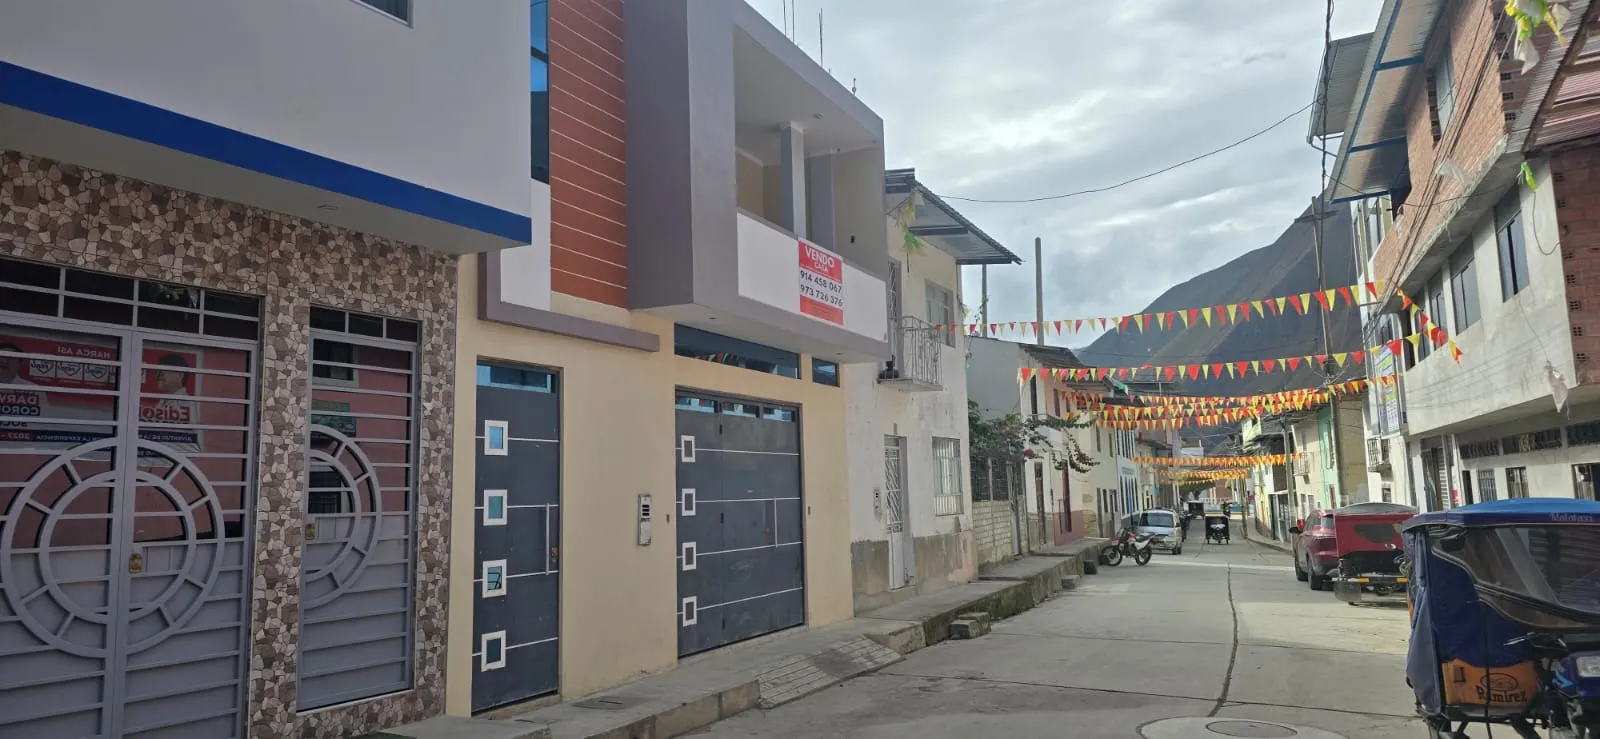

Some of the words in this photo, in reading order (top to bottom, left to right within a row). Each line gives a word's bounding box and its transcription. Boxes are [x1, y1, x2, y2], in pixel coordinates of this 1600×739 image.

[805, 246, 834, 268] VENDO
[800, 270, 813, 282] 914
[814, 277, 827, 288] 458
[829, 282, 843, 293] 067
[800, 284, 814, 296] 973
[816, 290, 829, 302] 726
[831, 295, 843, 307] 376
